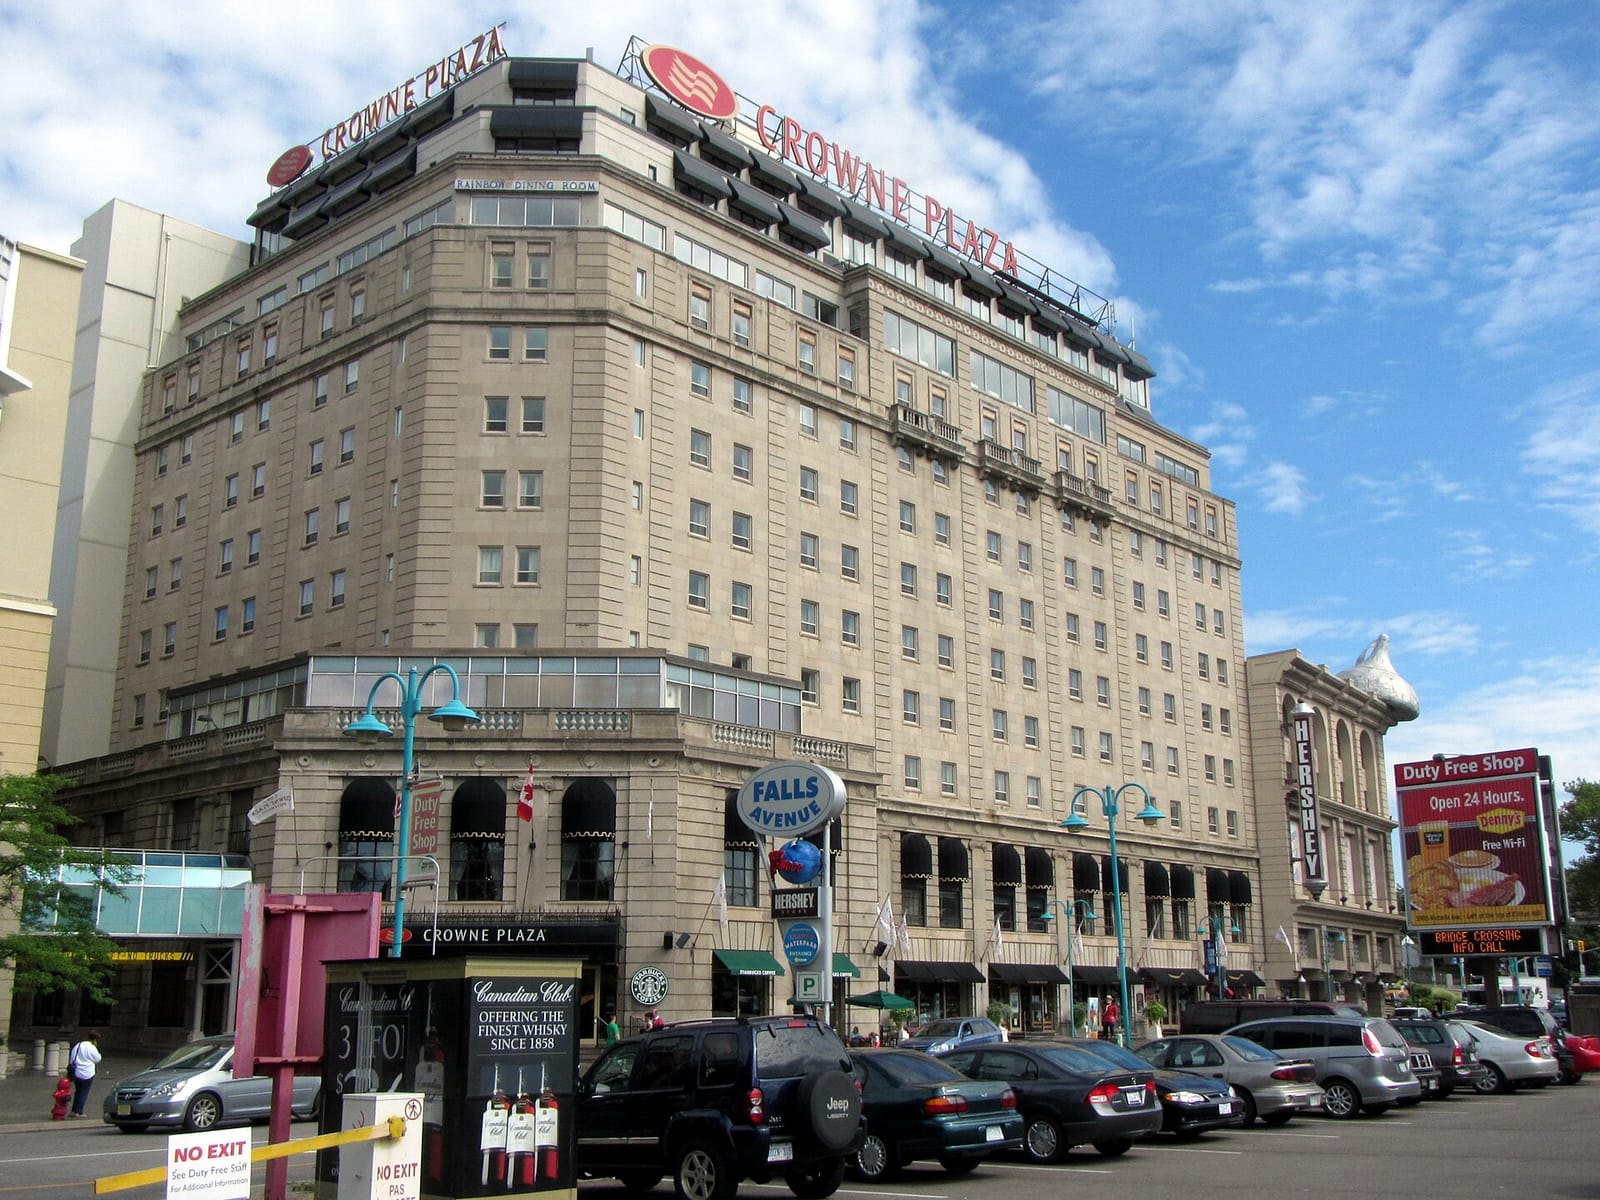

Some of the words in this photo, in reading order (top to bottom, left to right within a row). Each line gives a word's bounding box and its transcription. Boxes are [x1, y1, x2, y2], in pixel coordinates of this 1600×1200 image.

[322, 77, 417, 160] CROWNE
[425, 26, 504, 98] PLAZA
[514, 181, 554, 190] DINING
[562, 181, 596, 190] ROOM
[757, 104, 908, 223] CROWNE
[925, 195, 1019, 278] PLAZA
[1403, 764, 1440, 780] Duty
[1444, 761, 1478, 776] Free
[1482, 755, 1525, 772] Shop
[753, 776, 819, 803] FALLS
[1295, 720, 1318, 876] HERSHEY
[414, 797, 438, 815] Duty
[1430, 796, 1460, 812] Open
[1464, 792, 1480, 807] 24
[1483, 790, 1524, 805] Hours.
[749, 800, 821, 828] AVENUE
[1481, 812, 1521, 828] Denny's
[414, 816, 436, 831] Free
[412, 833, 436, 852] Shop
[1482, 840, 1501, 850] Free
[1502, 837, 1526, 849] Wi-Fi
[774, 892, 814, 910] HERSHEY
[423, 928, 489, 942] CROWNE
[497, 928, 546, 942] PLAZA
[1435, 931, 1468, 943] BRIDGE
[1473, 929, 1521, 942] CROSSING
[1452, 942, 1475, 953] INFO
[1480, 941, 1506, 953] CALL
[633, 969, 666, 985] STARBUCKS
[803, 977, 815, 992] P
[474, 981, 539, 1003] Canadian
[636, 992, 661, 1003] COFFEE
[479, 1010, 538, 1023] OFFERING
[541, 1010, 564, 1022] THE
[478, 1025, 520, 1037] FINEST
[522, 1023, 568, 1036] WHISKY
[338, 1024, 351, 1060] 3
[490, 1038, 527, 1051] SINCE
[530, 1037, 555, 1050] 1858
[826, 1096, 849, 1112] Jeep
[174, 1145, 203, 1163] NO
[207, 1140, 247, 1159] EXIT
[171, 1170, 186, 1180] See
[188, 1168, 209, 1179] Duty
[211, 1165, 229, 1175] Free
[230, 1162, 248, 1173] Staff
[377, 1164, 391, 1181] NO
[394, 1162, 418, 1179] EXIT
[170, 1184, 181, 1193] For
[182, 1180, 213, 1192] Additional
[214, 1176, 249, 1187] Information
[389, 1183, 405, 1197] PAS
